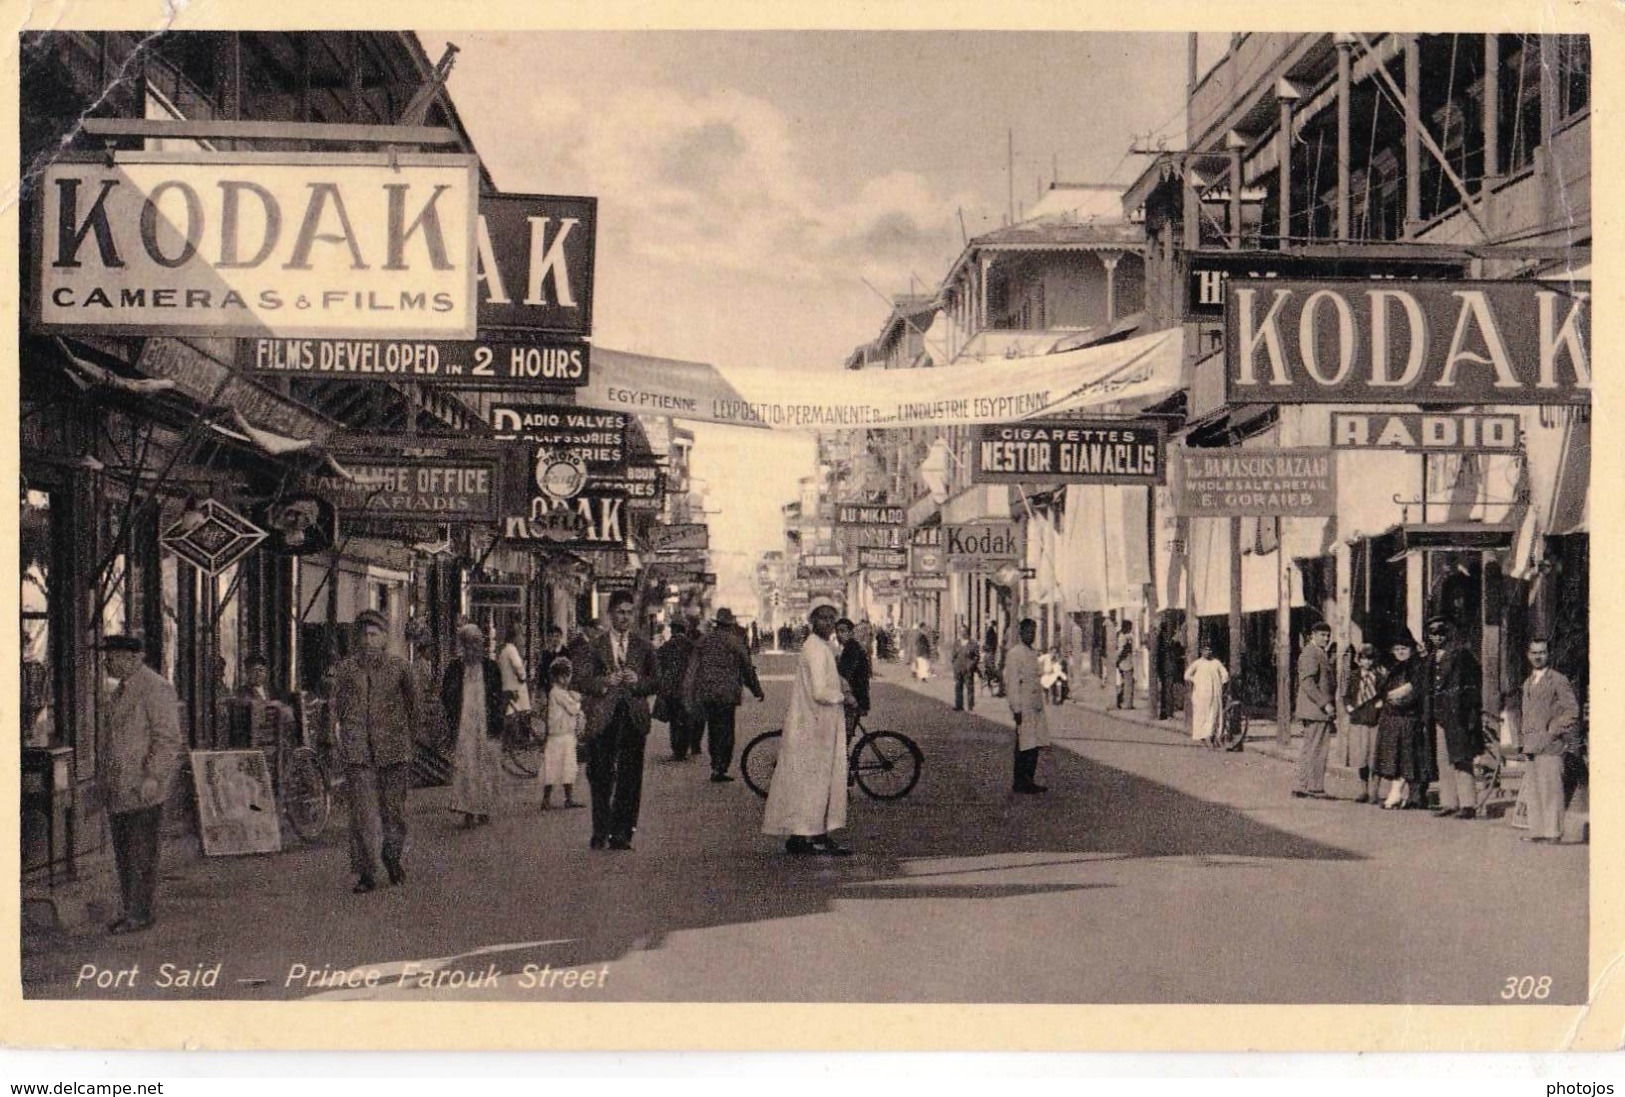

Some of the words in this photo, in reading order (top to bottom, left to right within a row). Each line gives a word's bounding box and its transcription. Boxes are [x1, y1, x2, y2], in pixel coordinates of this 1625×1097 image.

[51, 177, 455, 271] KODAK
[51, 287, 283, 310] CAMERAS
[323, 289, 455, 312] FILMS
[1234, 288, 1592, 389] KODAK
[255, 339, 315, 371] FILMS
[320, 342, 439, 375] DEVELOPED
[445, 362, 462, 373] IN
[472, 347, 495, 377] 2
[511, 348, 583, 379] HOURS
[608, 387, 697, 412] EGYPTIENNE
[567, 414, 626, 429] VALVES
[1336, 415, 1515, 448] RADIO
[1001, 428, 1135, 443] CIGARETTES
[981, 441, 1052, 473] NESTOR
[1059, 443, 1156, 476] GIANACLIS
[1204, 458, 1274, 478] DAMASCUS
[1275, 457, 1329, 477] BAZAAR
[417, 468, 488, 494] OFFICE
[1185, 480, 1272, 492] WHOLESALE
[1282, 480, 1328, 491] RETAIL
[839, 508, 857, 524] AU
[859, 507, 906, 524] MIKADO
[946, 526, 1018, 555] Kodak
